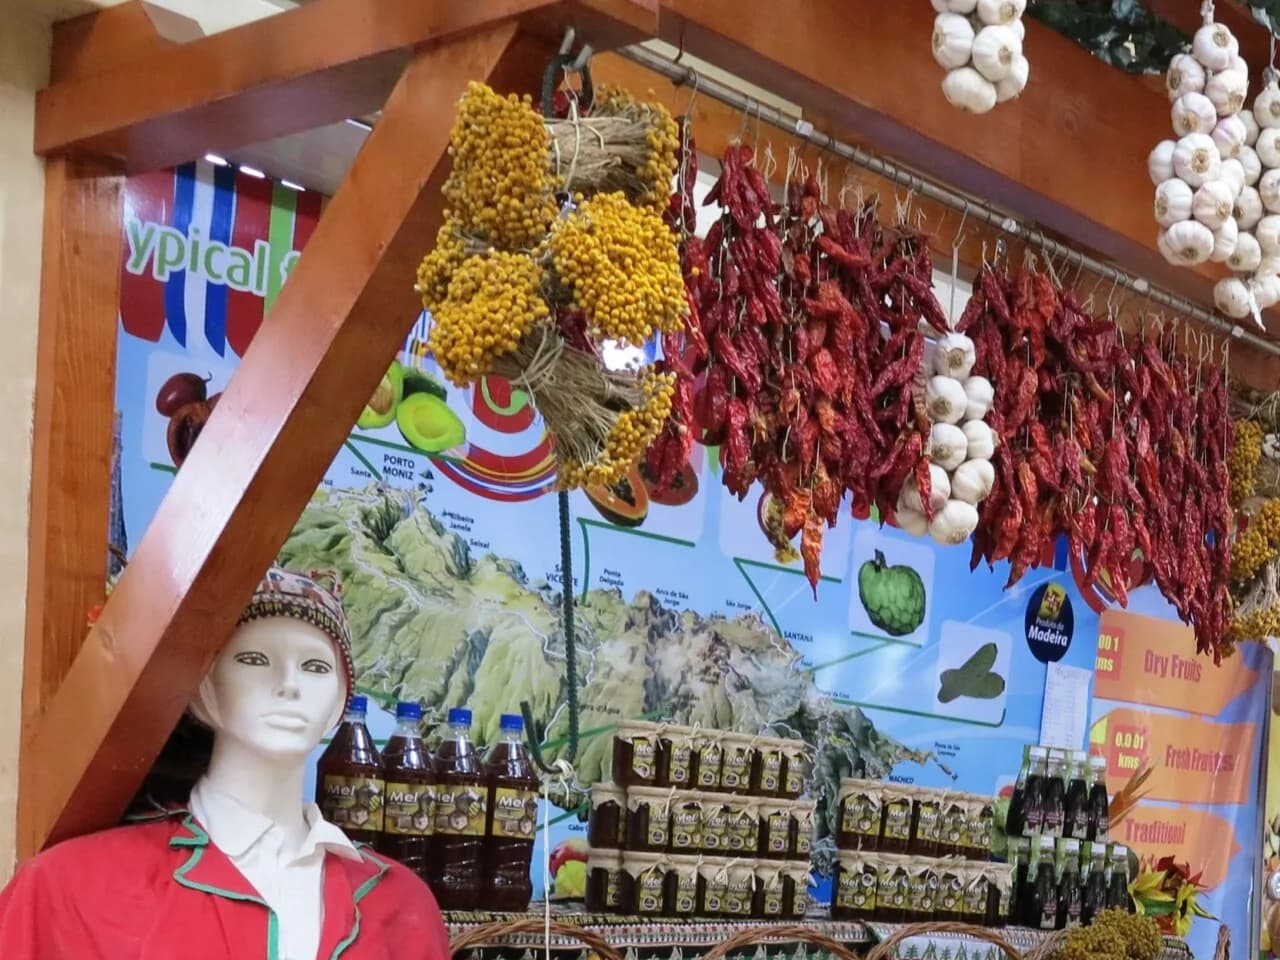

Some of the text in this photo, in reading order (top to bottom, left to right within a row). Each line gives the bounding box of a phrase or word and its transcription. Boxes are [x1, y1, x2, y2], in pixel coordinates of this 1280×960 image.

[126, 220, 270, 296] ypical
[383, 454, 415, 469] PORTO
[350, 467, 372, 478] Santa
[382, 466, 414, 480] MONIZ
[308, 609, 338, 630] MADE
[784, 631, 814, 643] SANTANA
[1028, 625, 1068, 646] Madeira
[1144, 648, 1202, 682] Dry Fruits
[1118, 753, 1139, 769] kms
[328, 784, 355, 796] Mel
[390, 791, 418, 803] Mel
[499, 796, 526, 808] Mel
[890, 809, 907, 818] Mel
[841, 879, 858, 888] Mel
[880, 879, 898, 889] Mel
